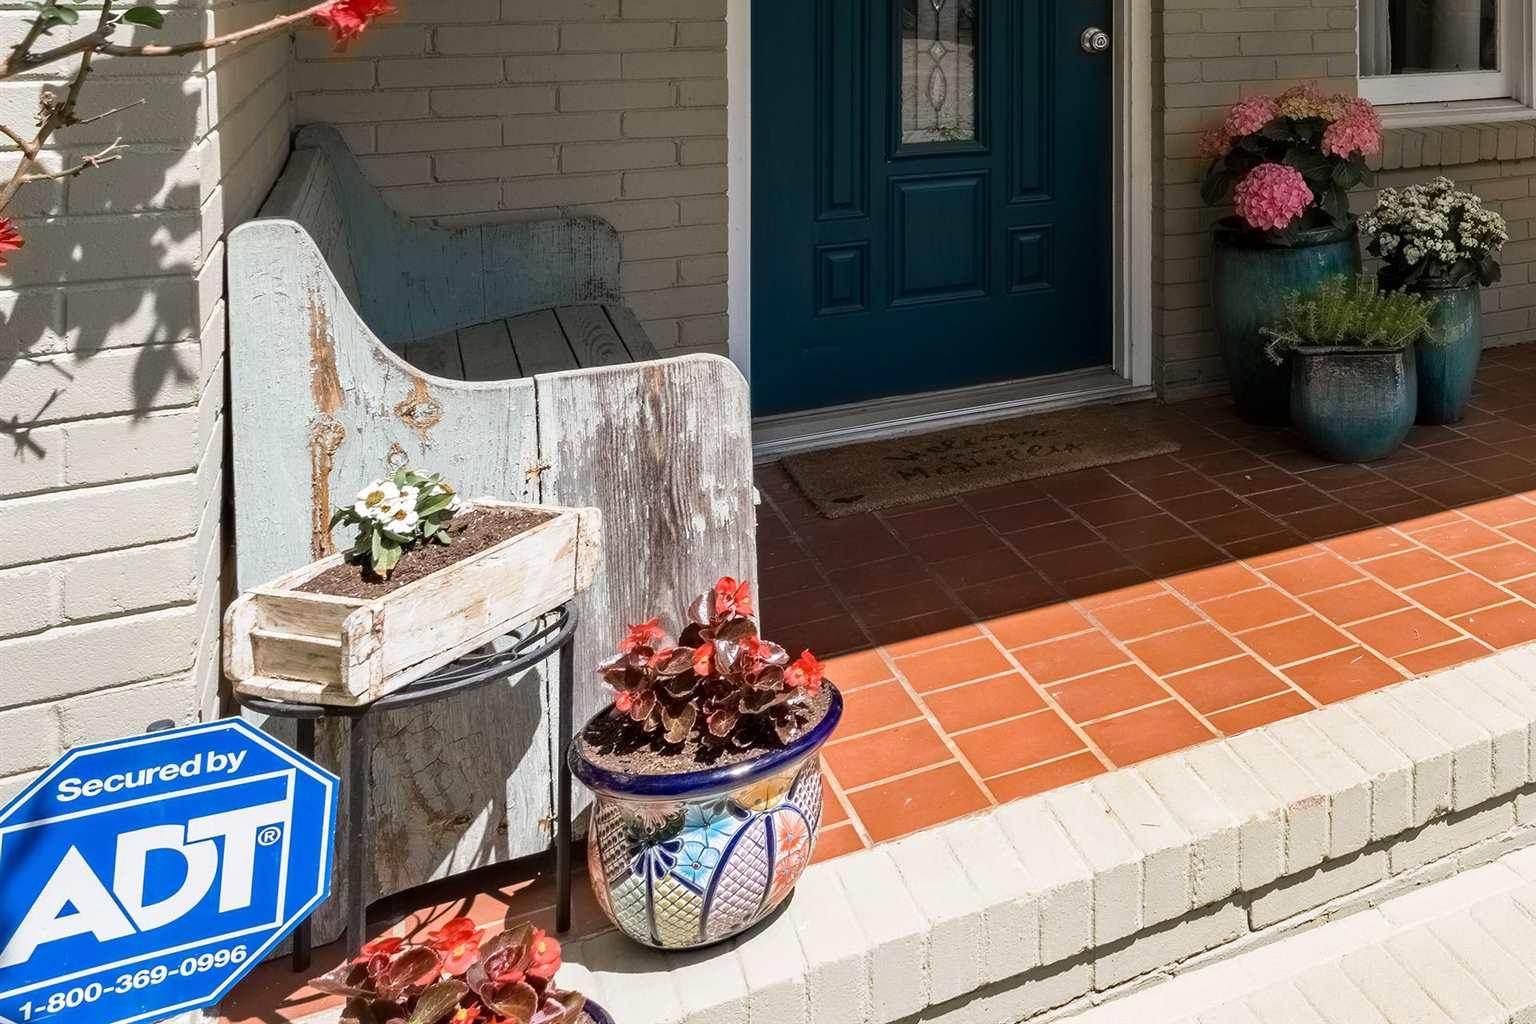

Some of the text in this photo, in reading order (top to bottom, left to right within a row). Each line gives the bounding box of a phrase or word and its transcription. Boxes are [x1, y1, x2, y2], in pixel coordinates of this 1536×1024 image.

[56, 749, 248, 802] Secured by
[0, 800, 290, 969] ADT
[19, 944, 248, 1021] 1-800-369-0996
